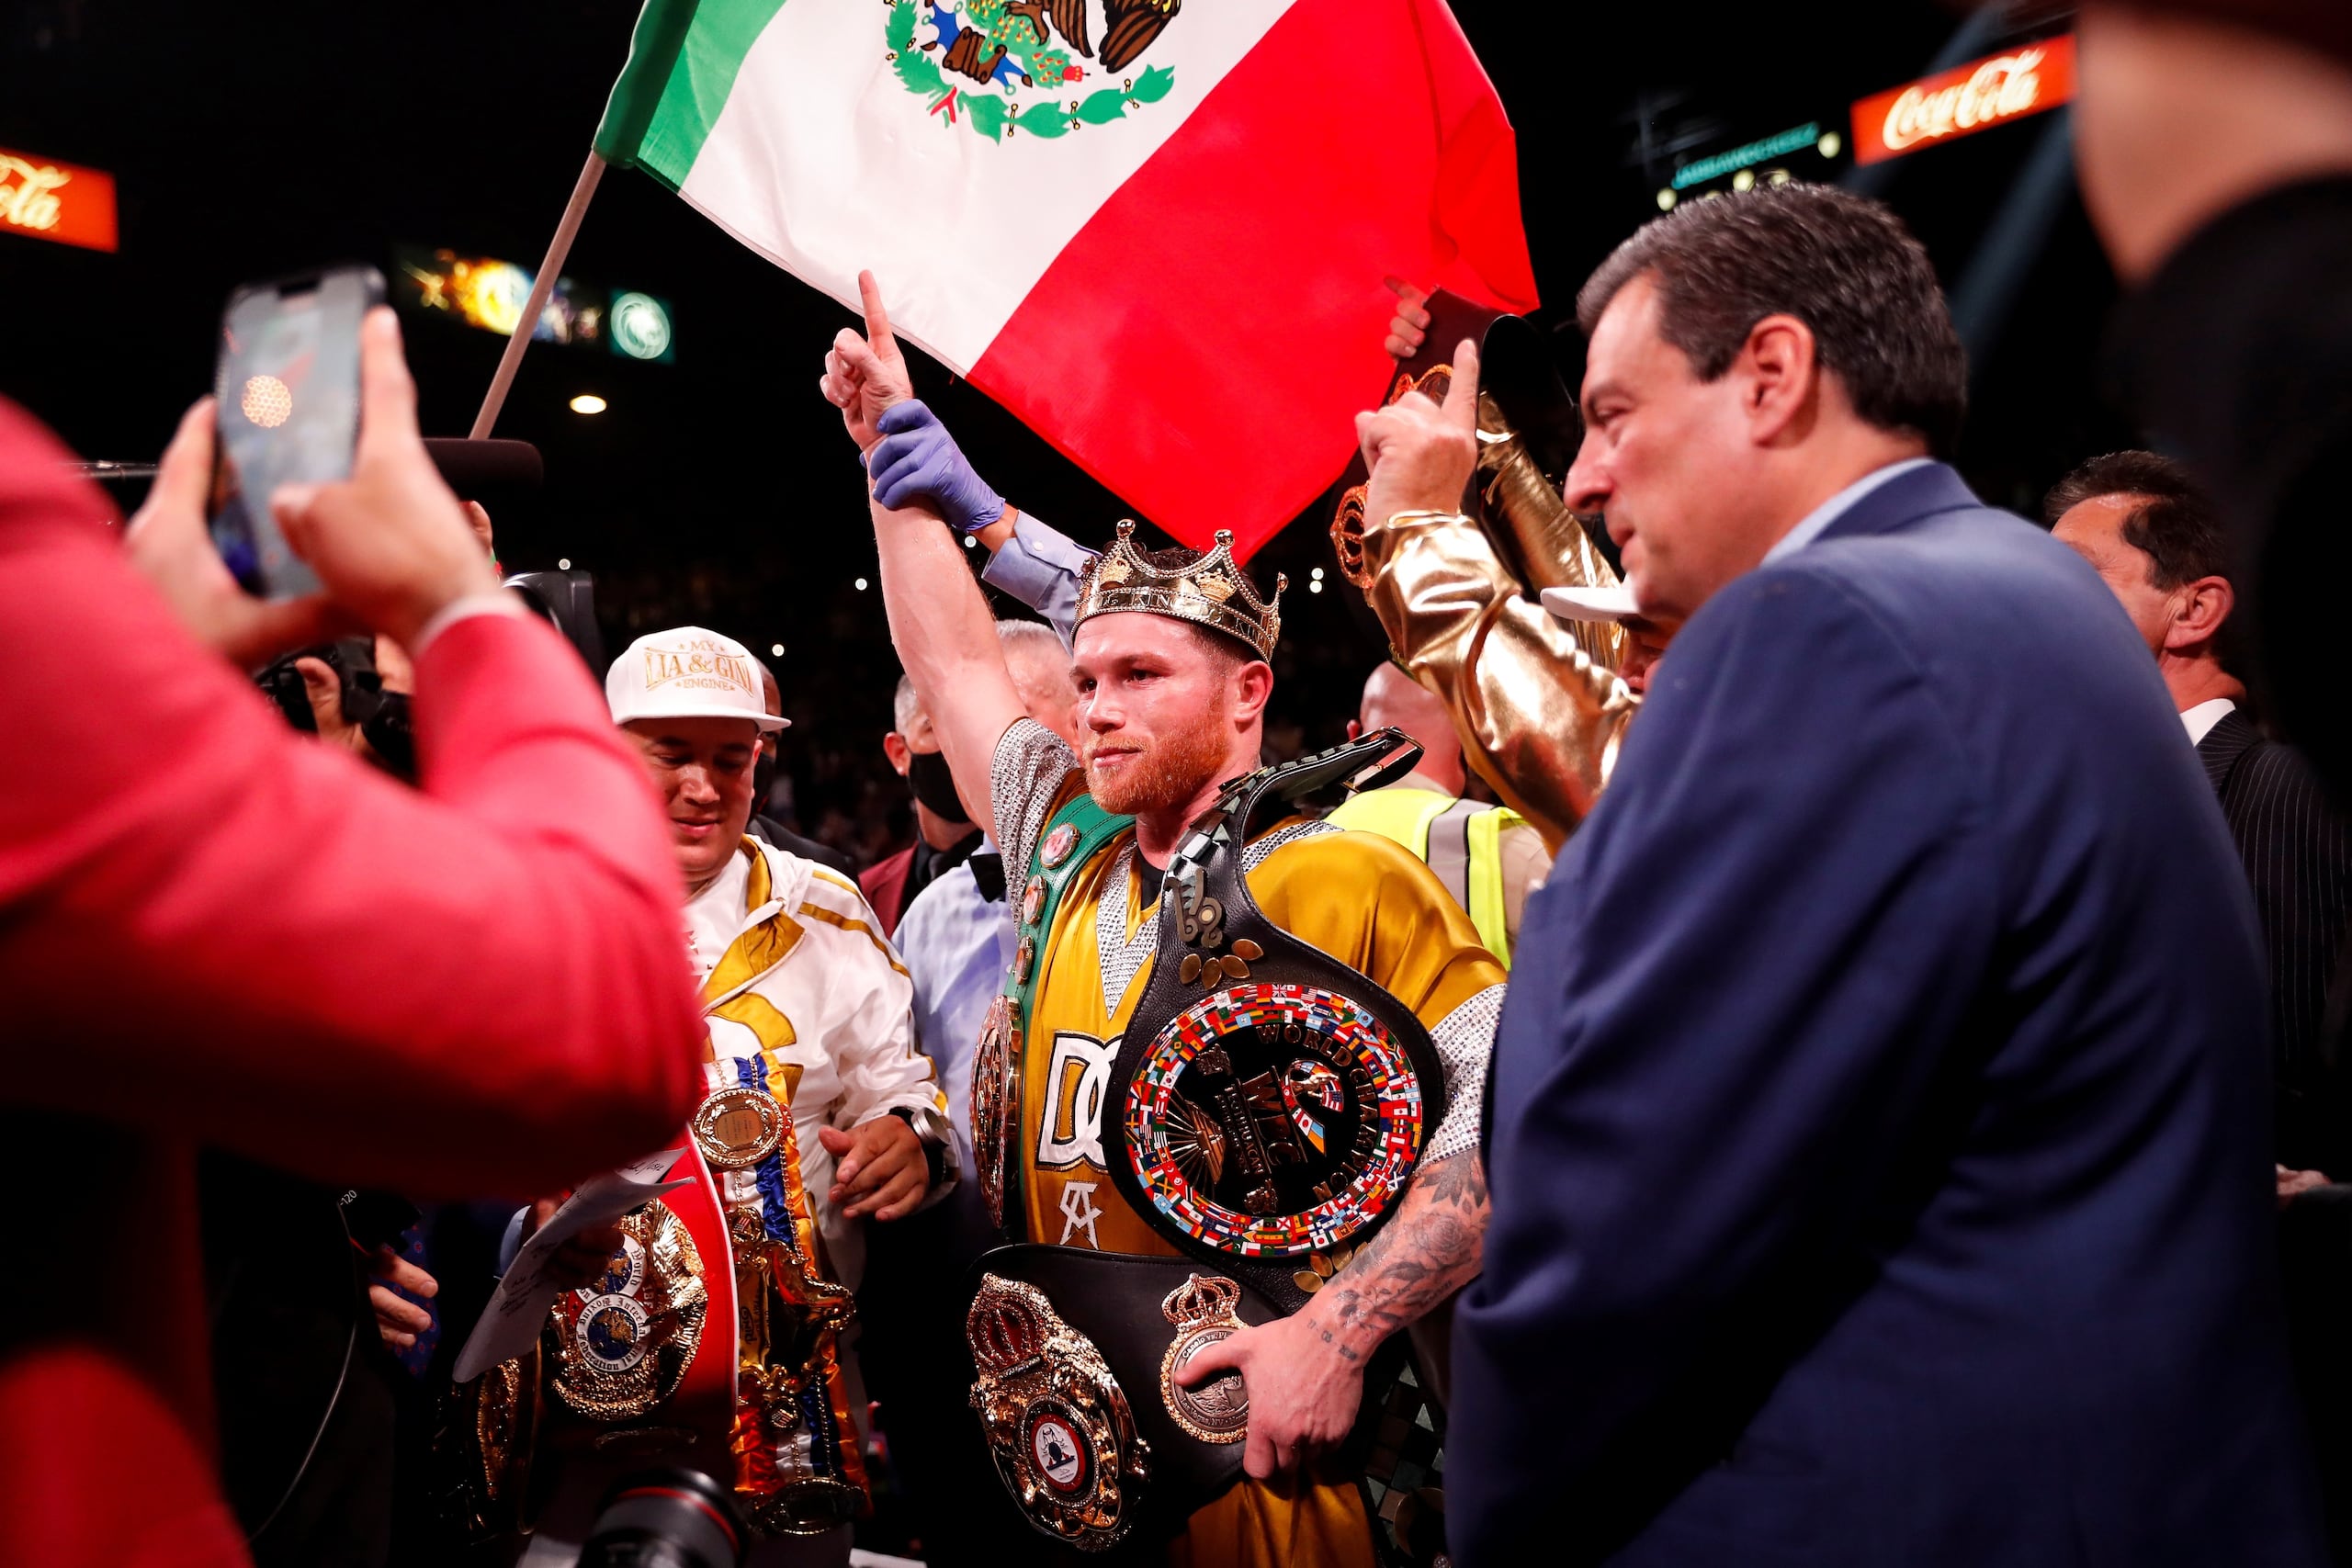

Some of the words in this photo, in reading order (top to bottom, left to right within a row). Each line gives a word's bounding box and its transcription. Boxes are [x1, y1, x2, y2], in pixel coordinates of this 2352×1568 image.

[690, 639, 717, 652] MY
[644, 650, 684, 690] LIA
[688, 653, 714, 674] &
[714, 656, 755, 695] GIN
[684, 678, 730, 691] ENGINE
[1255, 1023, 1353, 1067] WORLD
[1312, 1067, 1378, 1202] CHAMPION
[630, 1247, 644, 1287] World
[1182, 1337, 1205, 1359] Canelo
